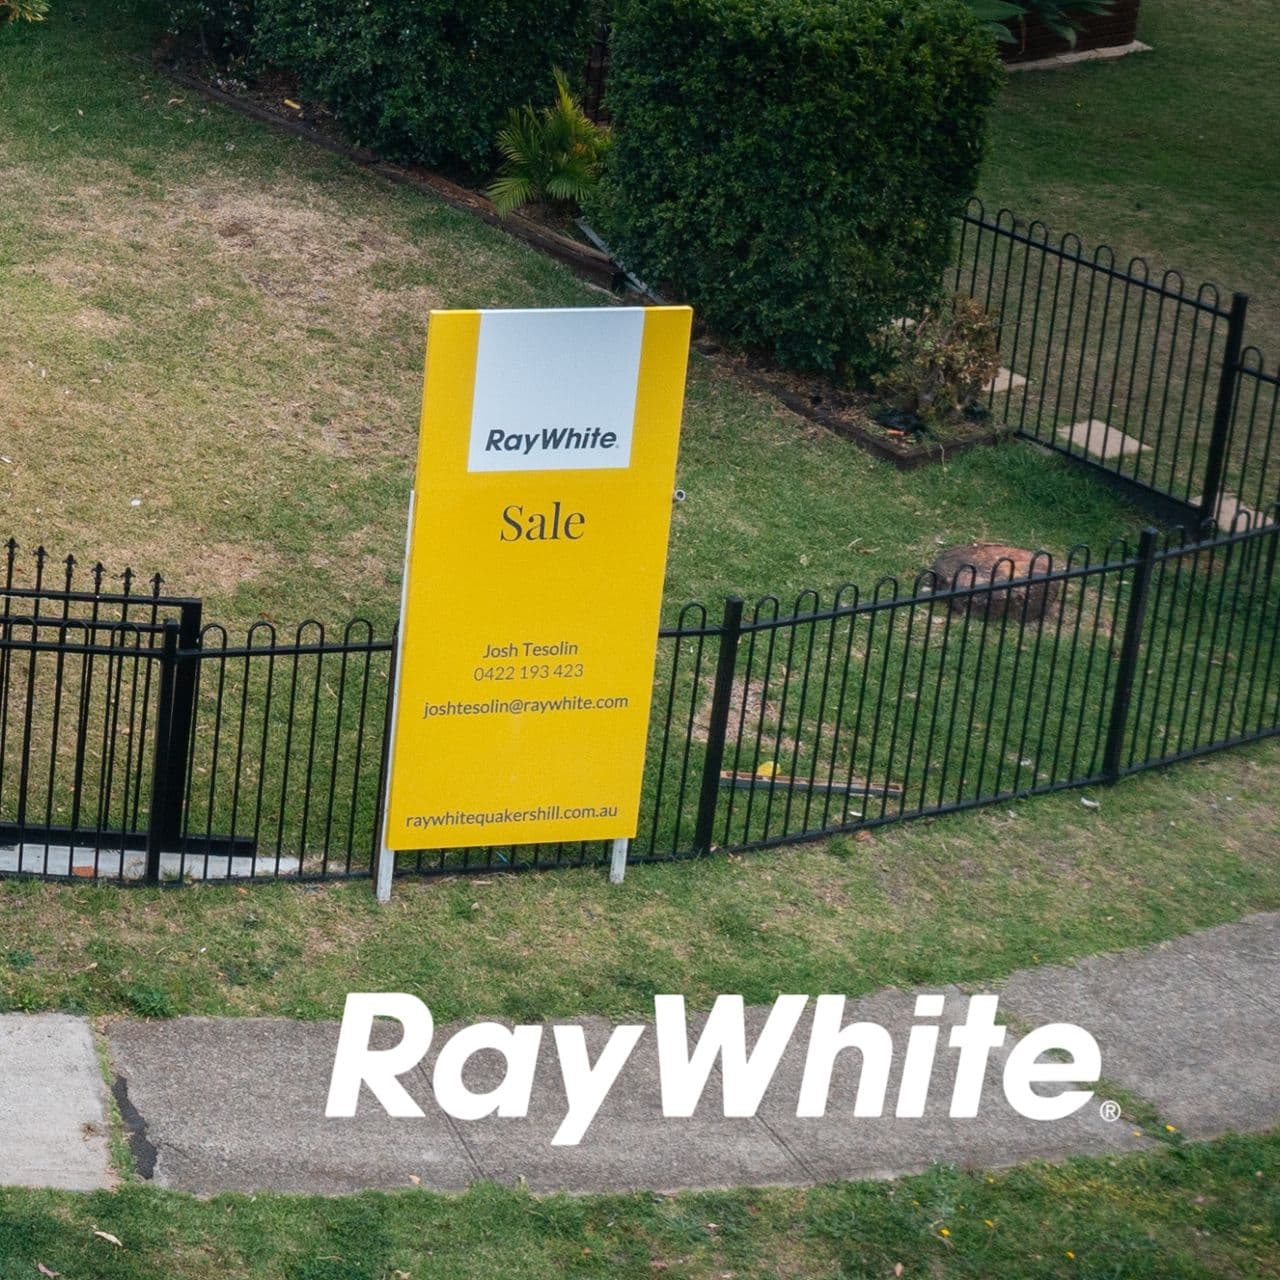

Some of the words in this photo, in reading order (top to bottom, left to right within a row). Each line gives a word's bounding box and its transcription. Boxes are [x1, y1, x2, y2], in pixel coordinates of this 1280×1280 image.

[500, 501, 585, 542] Sale
[482, 643, 519, 659] Josh
[523, 641, 579, 657] Tesolin
[474, 666, 516, 682] 0422
[520, 664, 550, 680] 193
[553, 662, 584, 678] 423
[423, 696, 629, 719] joshtesolin@raywhite.com
[406, 805, 618, 830] raywhitequakershill.com.au
